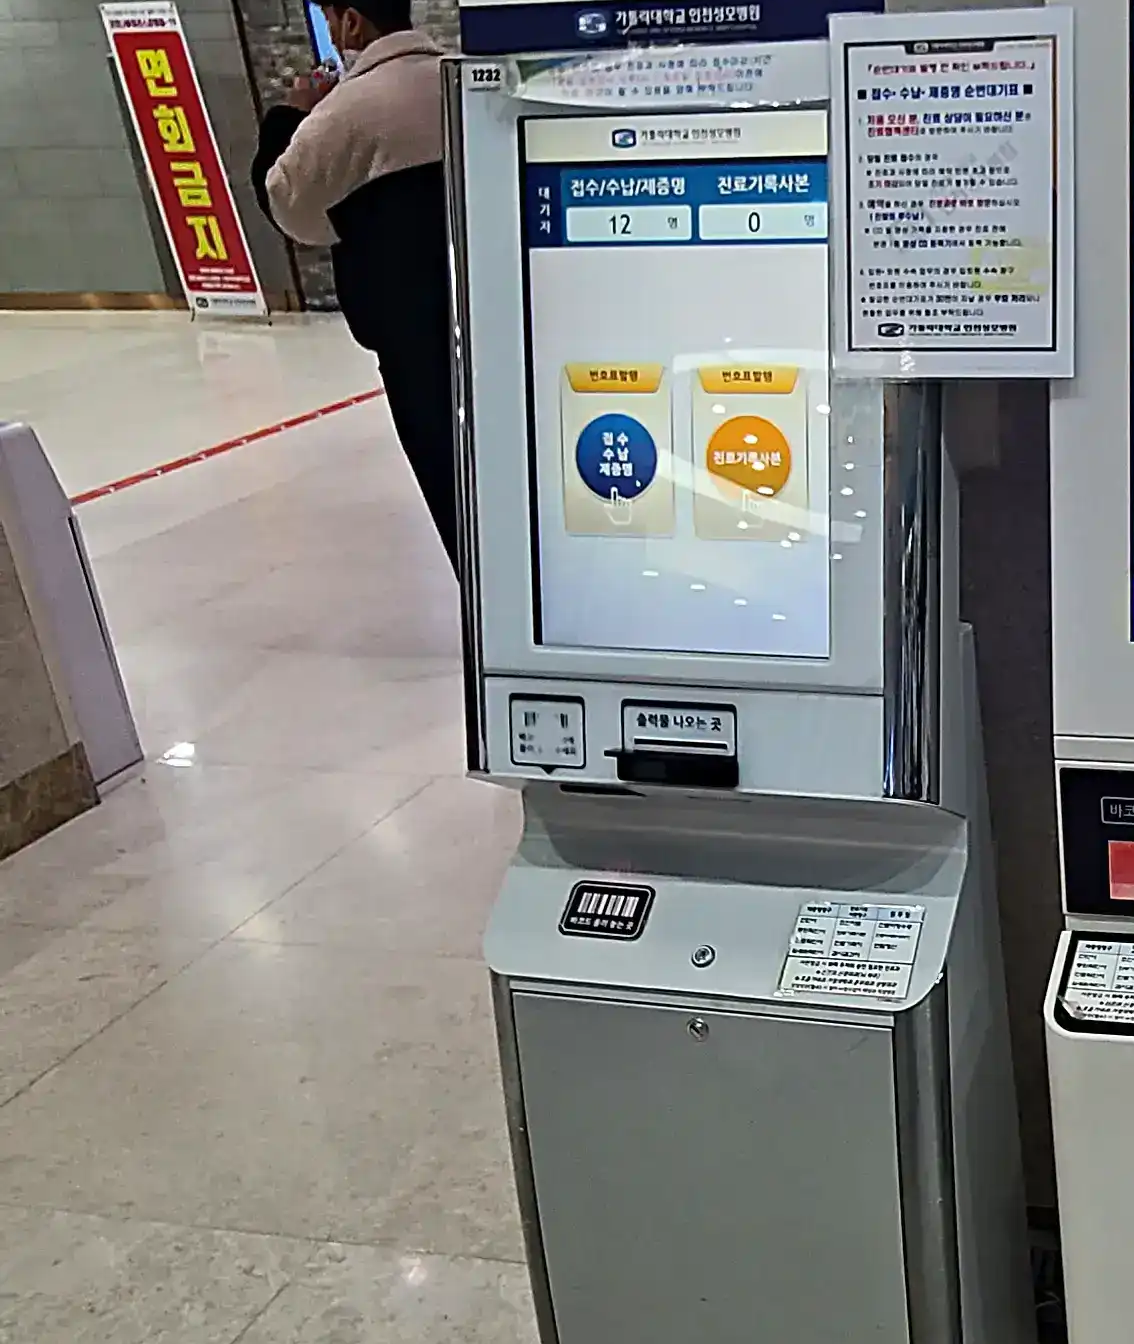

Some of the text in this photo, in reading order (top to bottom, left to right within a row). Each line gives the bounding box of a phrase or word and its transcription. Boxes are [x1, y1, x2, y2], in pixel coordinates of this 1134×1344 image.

[616, 4, 761, 27] 가톨릭대학교 인천성모병원
[134, 47, 229, 261] 면회금지
[570, 174, 810, 197] 접수/수납/제증명 진료기록사본
[609, 214, 631, 235] 12
[747, 212, 760, 233] 0
[602, 432, 629, 445] 접수
[603, 448, 629, 461] 수납
[599, 462, 633, 477] 제증명
[636, 712, 722, 732] 출력물 나오는 곳
